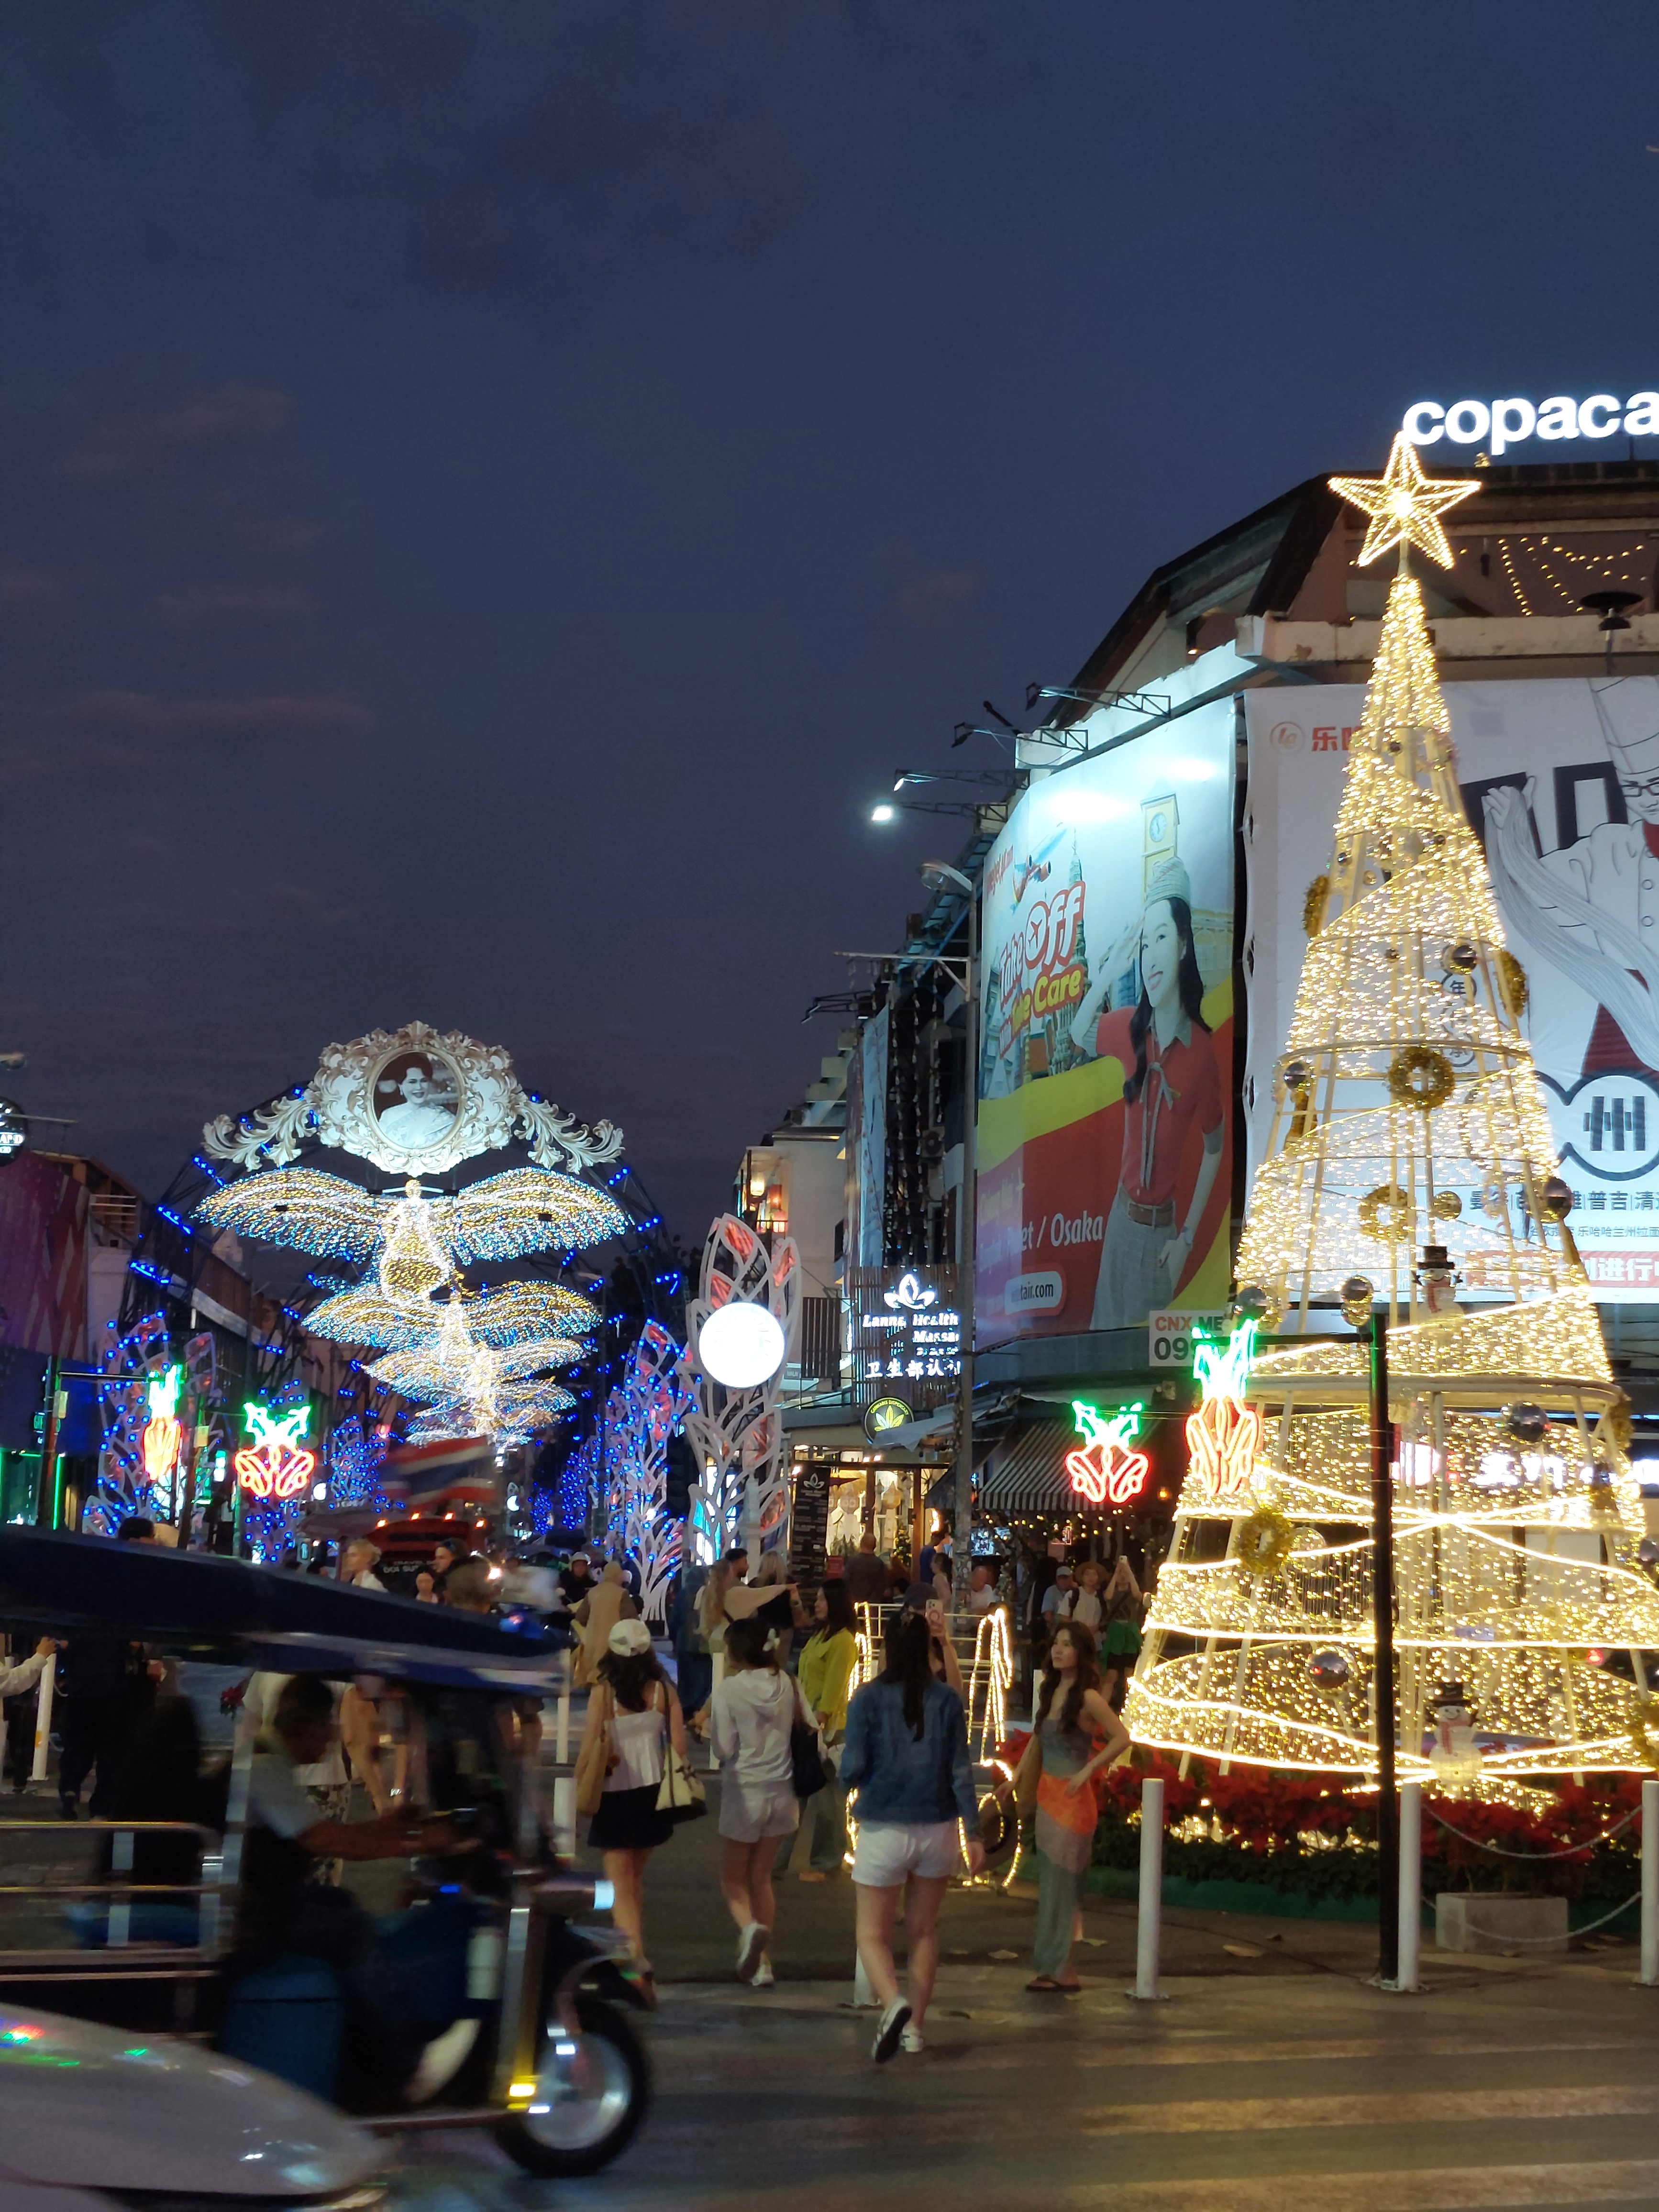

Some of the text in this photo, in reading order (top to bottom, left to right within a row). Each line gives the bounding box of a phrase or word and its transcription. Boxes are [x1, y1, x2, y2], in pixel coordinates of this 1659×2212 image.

[1404, 391, 1659, 456] copaca
[1026, 885, 1083, 965] Off
[1034, 969, 1081, 1013] Care
[1582, 1095, 1646, 1152] 州
[1051, 1210, 1103, 1247] Osaka
[912, 1330, 960, 1343] Massa
[1155, 1316, 1193, 1331] CNX
[1154, 1337, 1196, 1360] 09
